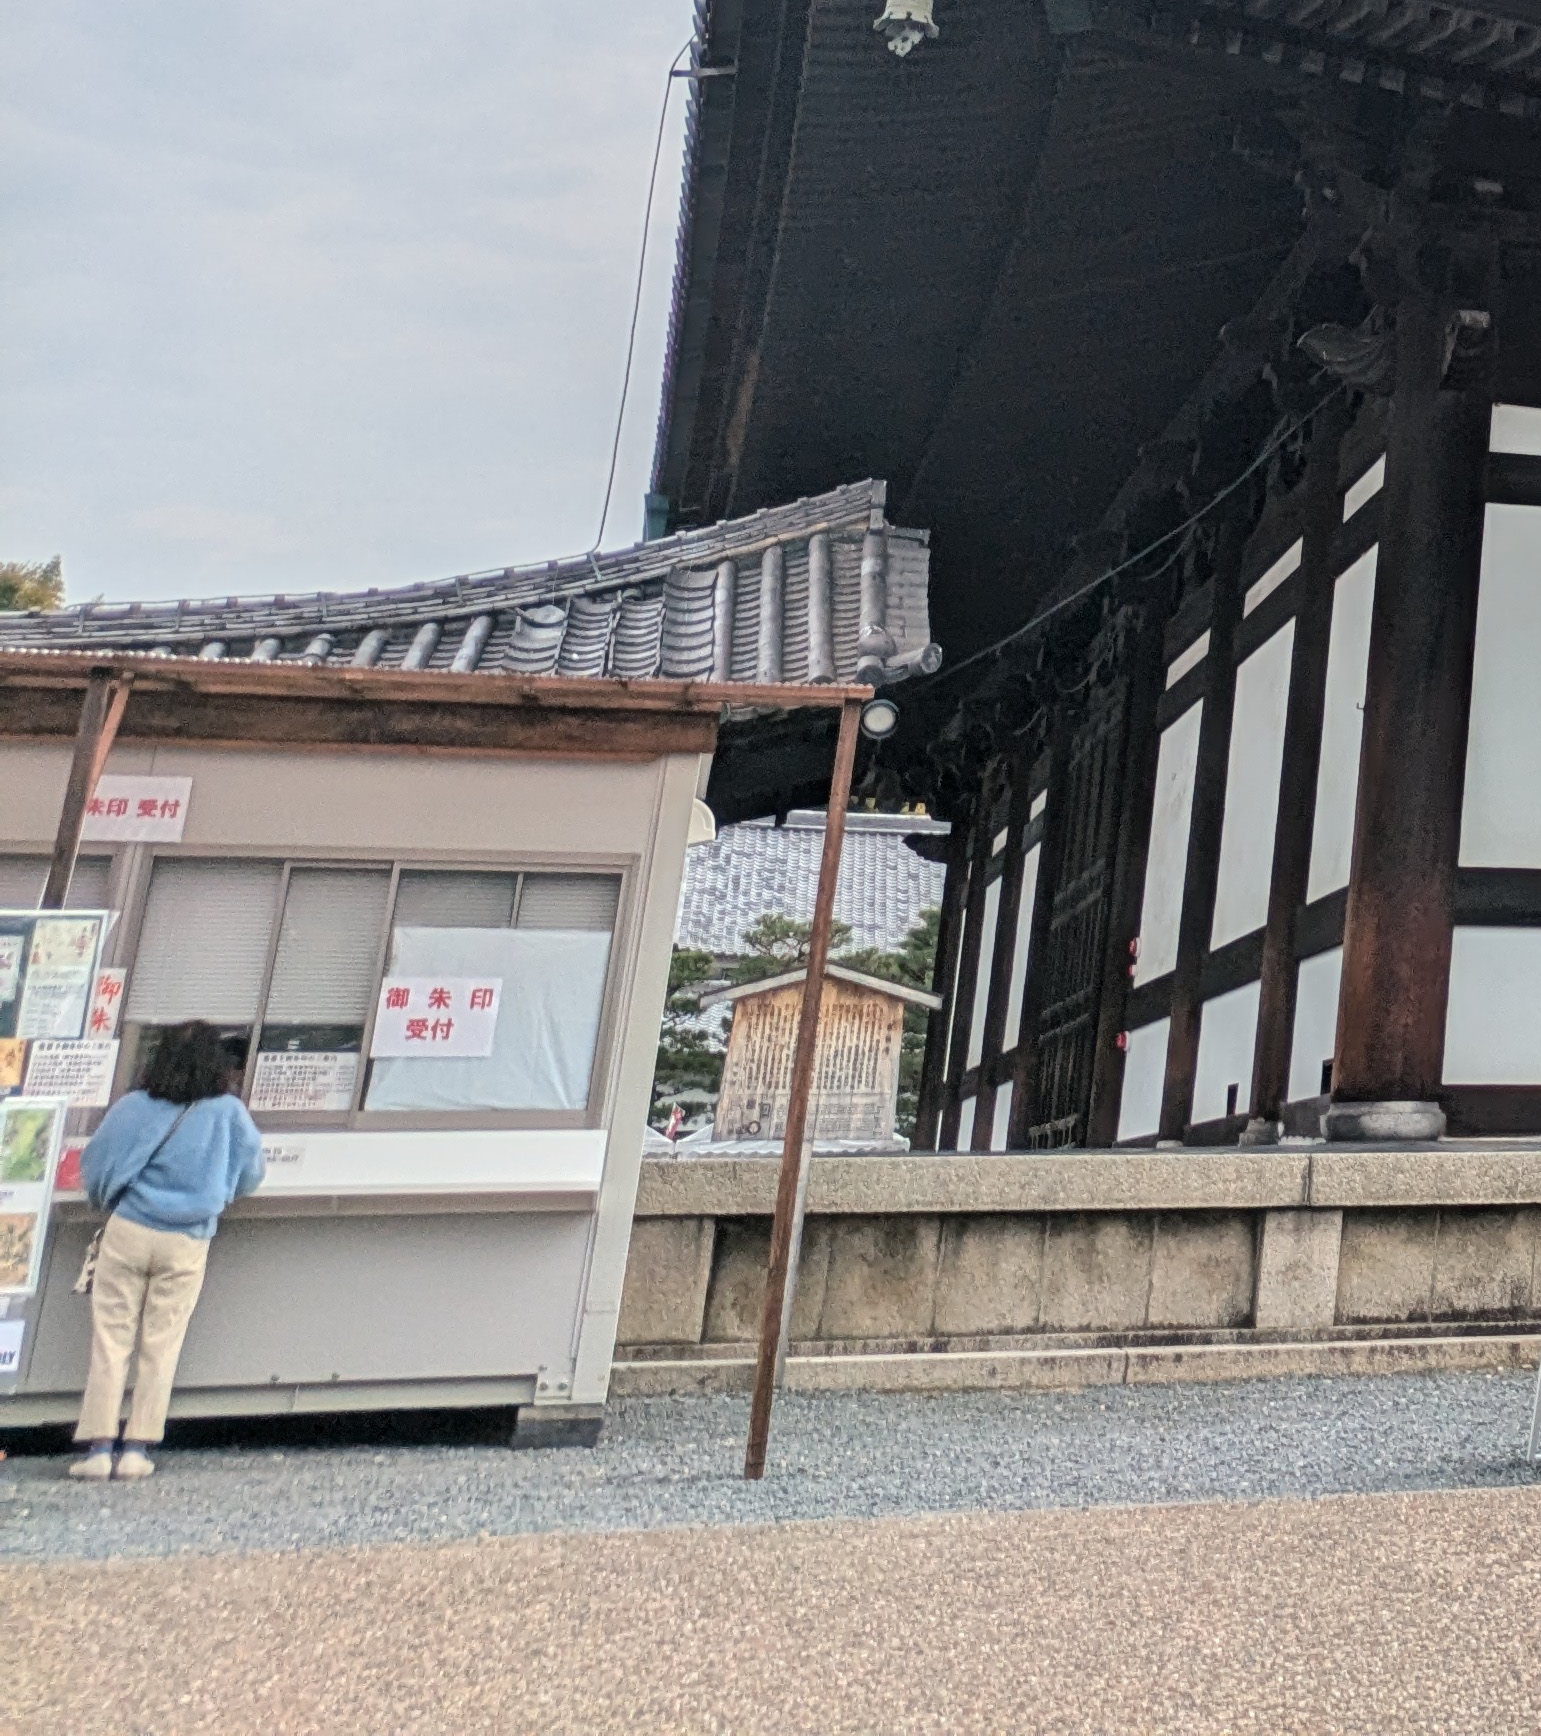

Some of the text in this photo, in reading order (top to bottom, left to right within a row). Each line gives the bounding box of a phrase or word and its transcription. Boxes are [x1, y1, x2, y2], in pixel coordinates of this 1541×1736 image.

[86, 798, 180, 818] 朱印 受付
[90, 975, 121, 1033] 御朱
[386, 987, 494, 1009] 御朱印
[405, 1017, 454, 1041] 受付
